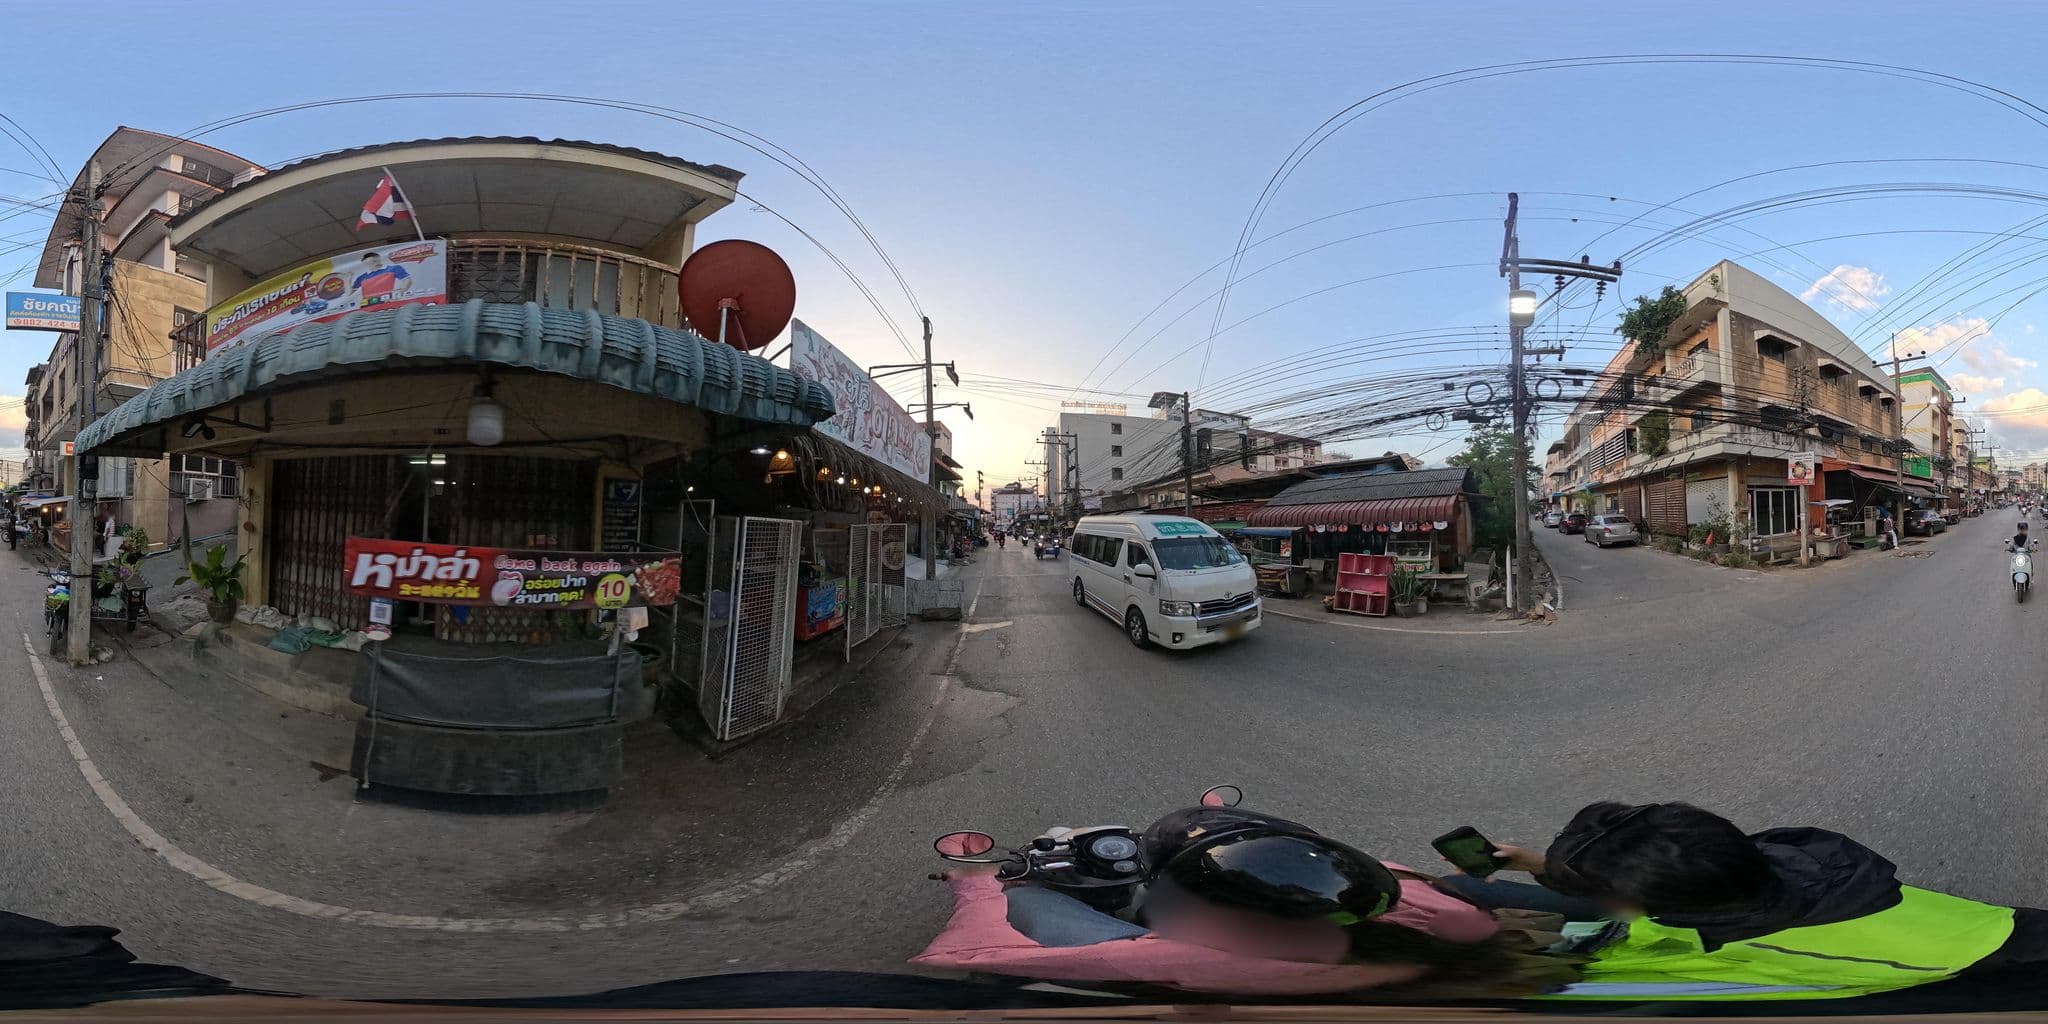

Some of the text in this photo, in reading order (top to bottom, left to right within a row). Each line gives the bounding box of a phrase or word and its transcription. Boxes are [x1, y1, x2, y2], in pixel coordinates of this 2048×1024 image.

[351, 547, 481, 589] หม่าล่า
[541, 556, 578, 572] back
[582, 558, 622, 576] again
[525, 574, 587, 591] อร่อยปาก
[600, 580, 626, 599] 10
